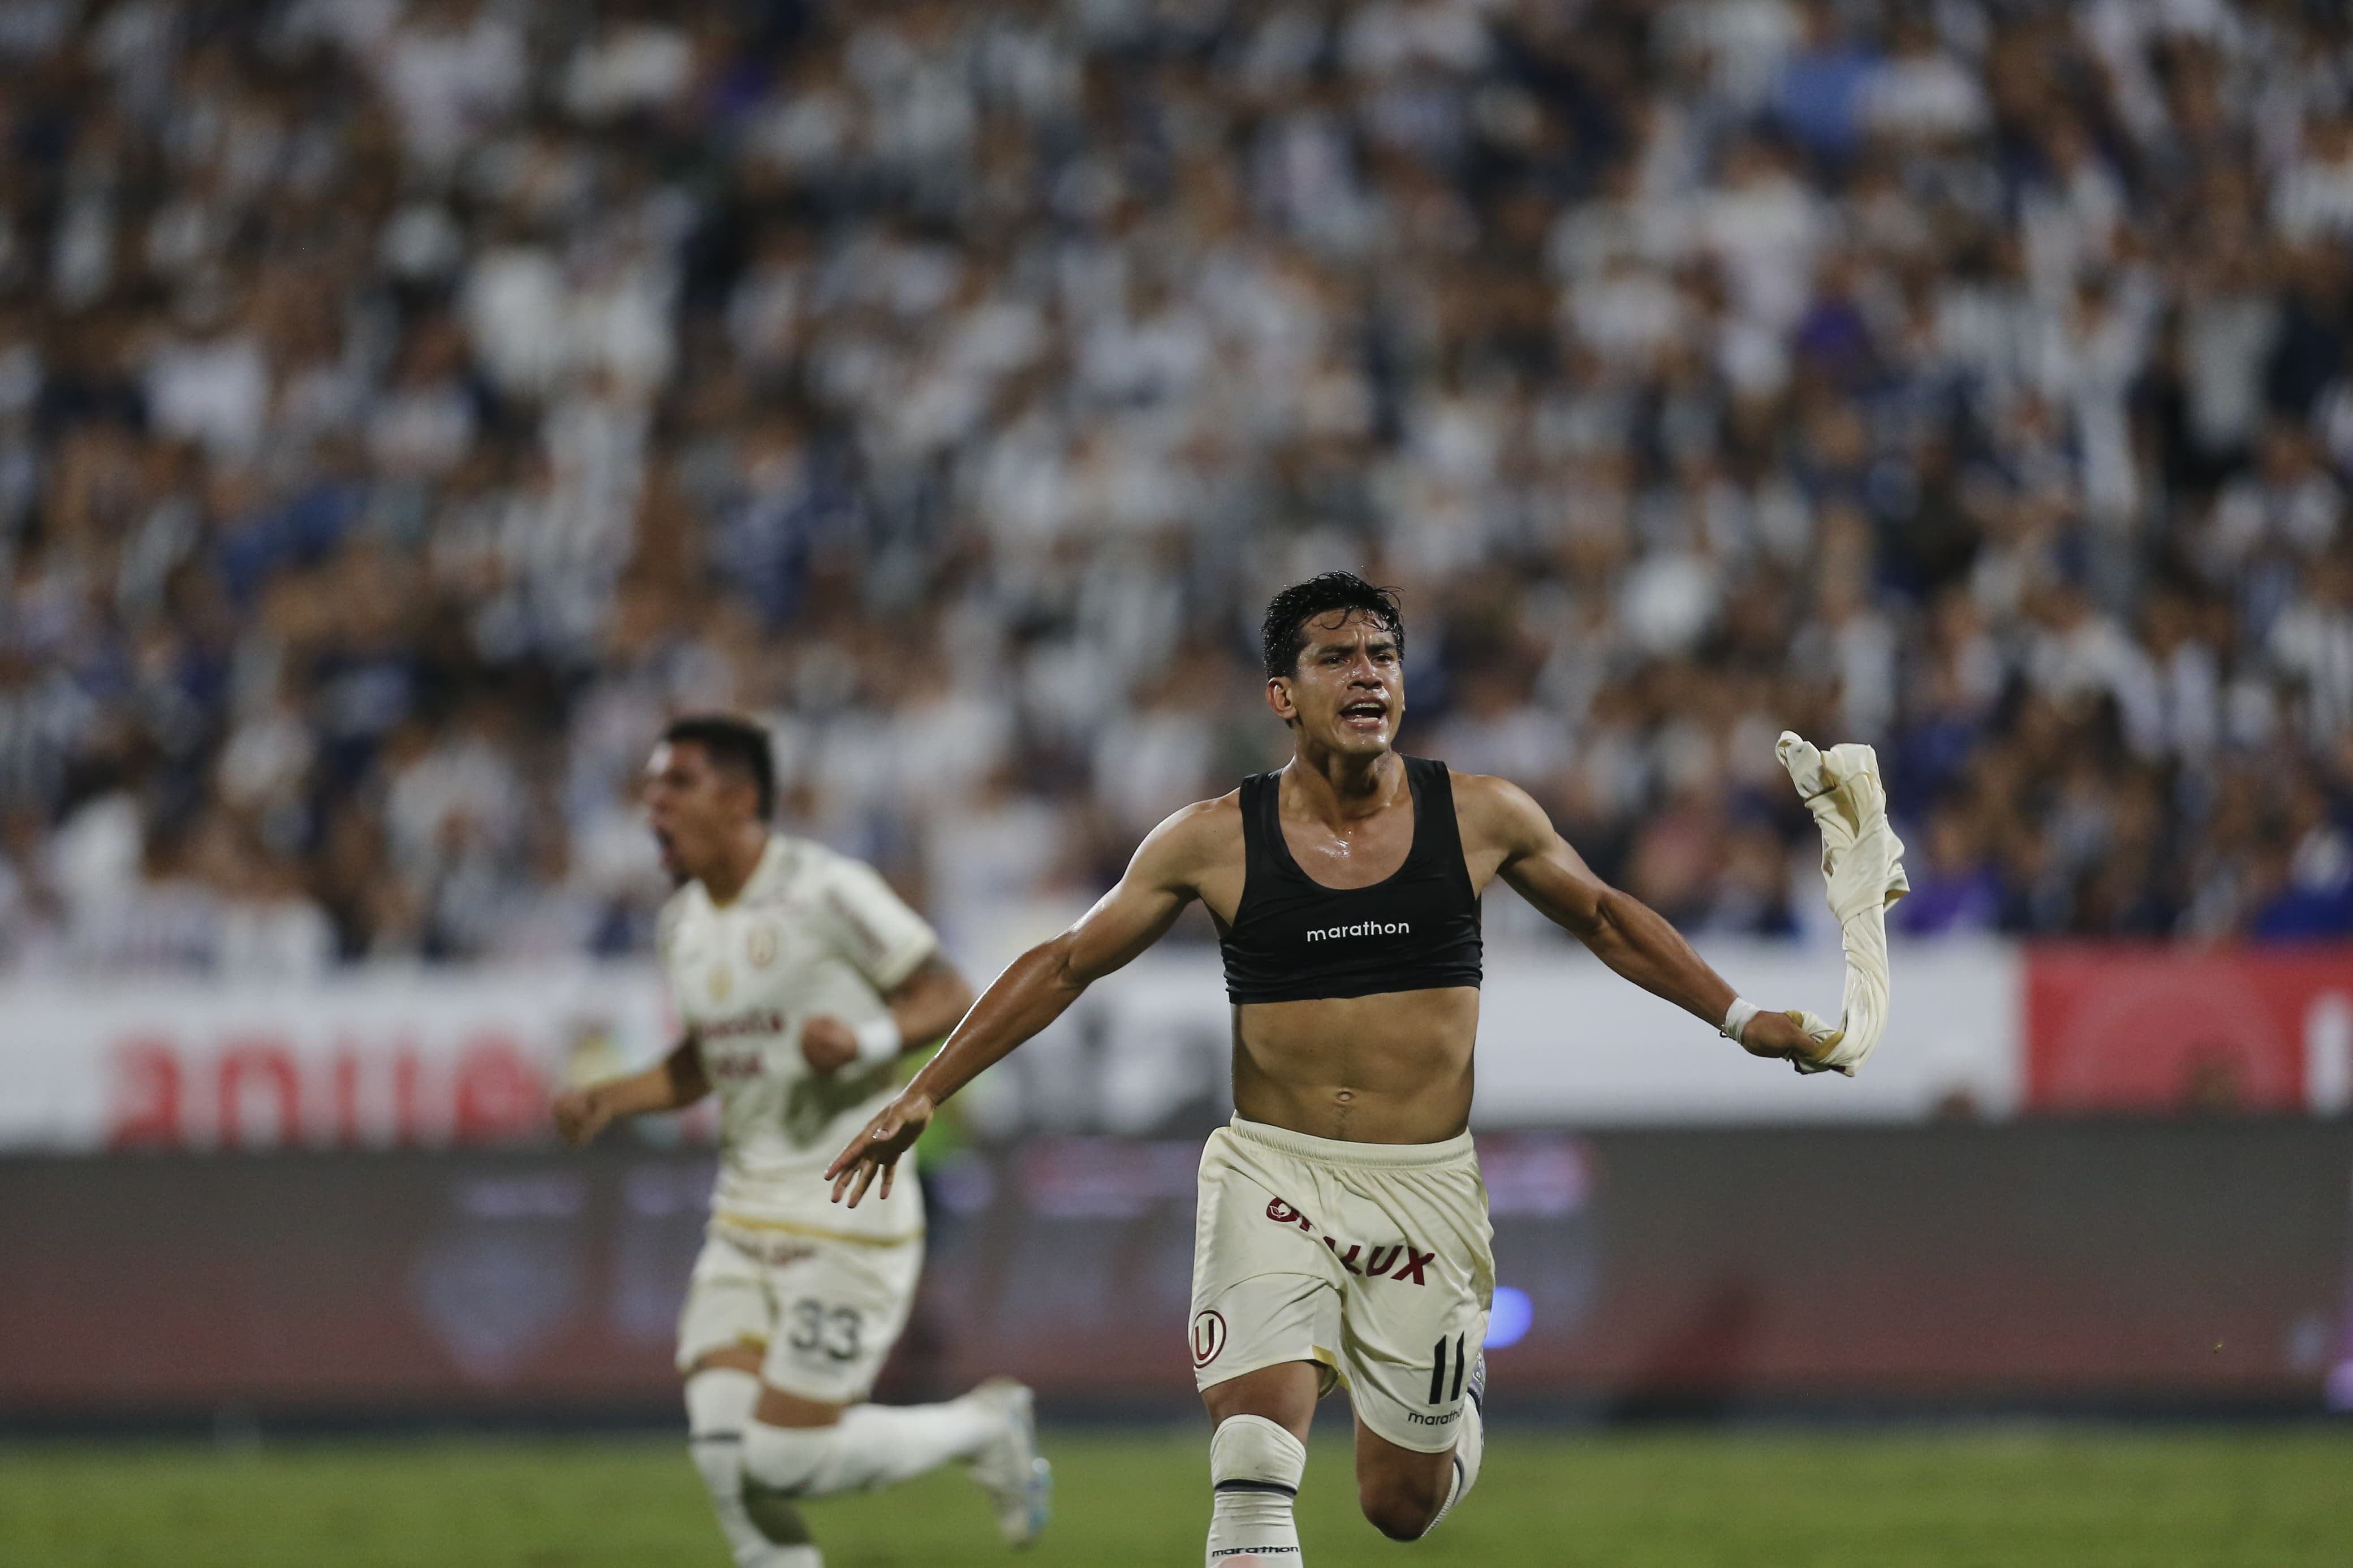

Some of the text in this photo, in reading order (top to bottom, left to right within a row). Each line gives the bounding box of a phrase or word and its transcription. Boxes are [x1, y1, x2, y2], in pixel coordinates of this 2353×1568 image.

[1307, 921, 1410, 942] marathon
[788, 1297, 863, 1363] 33
[1193, 1316, 1216, 1362] U
[1429, 1331, 1465, 1405] 11
[1212, 1546, 1299, 1557] marathon
